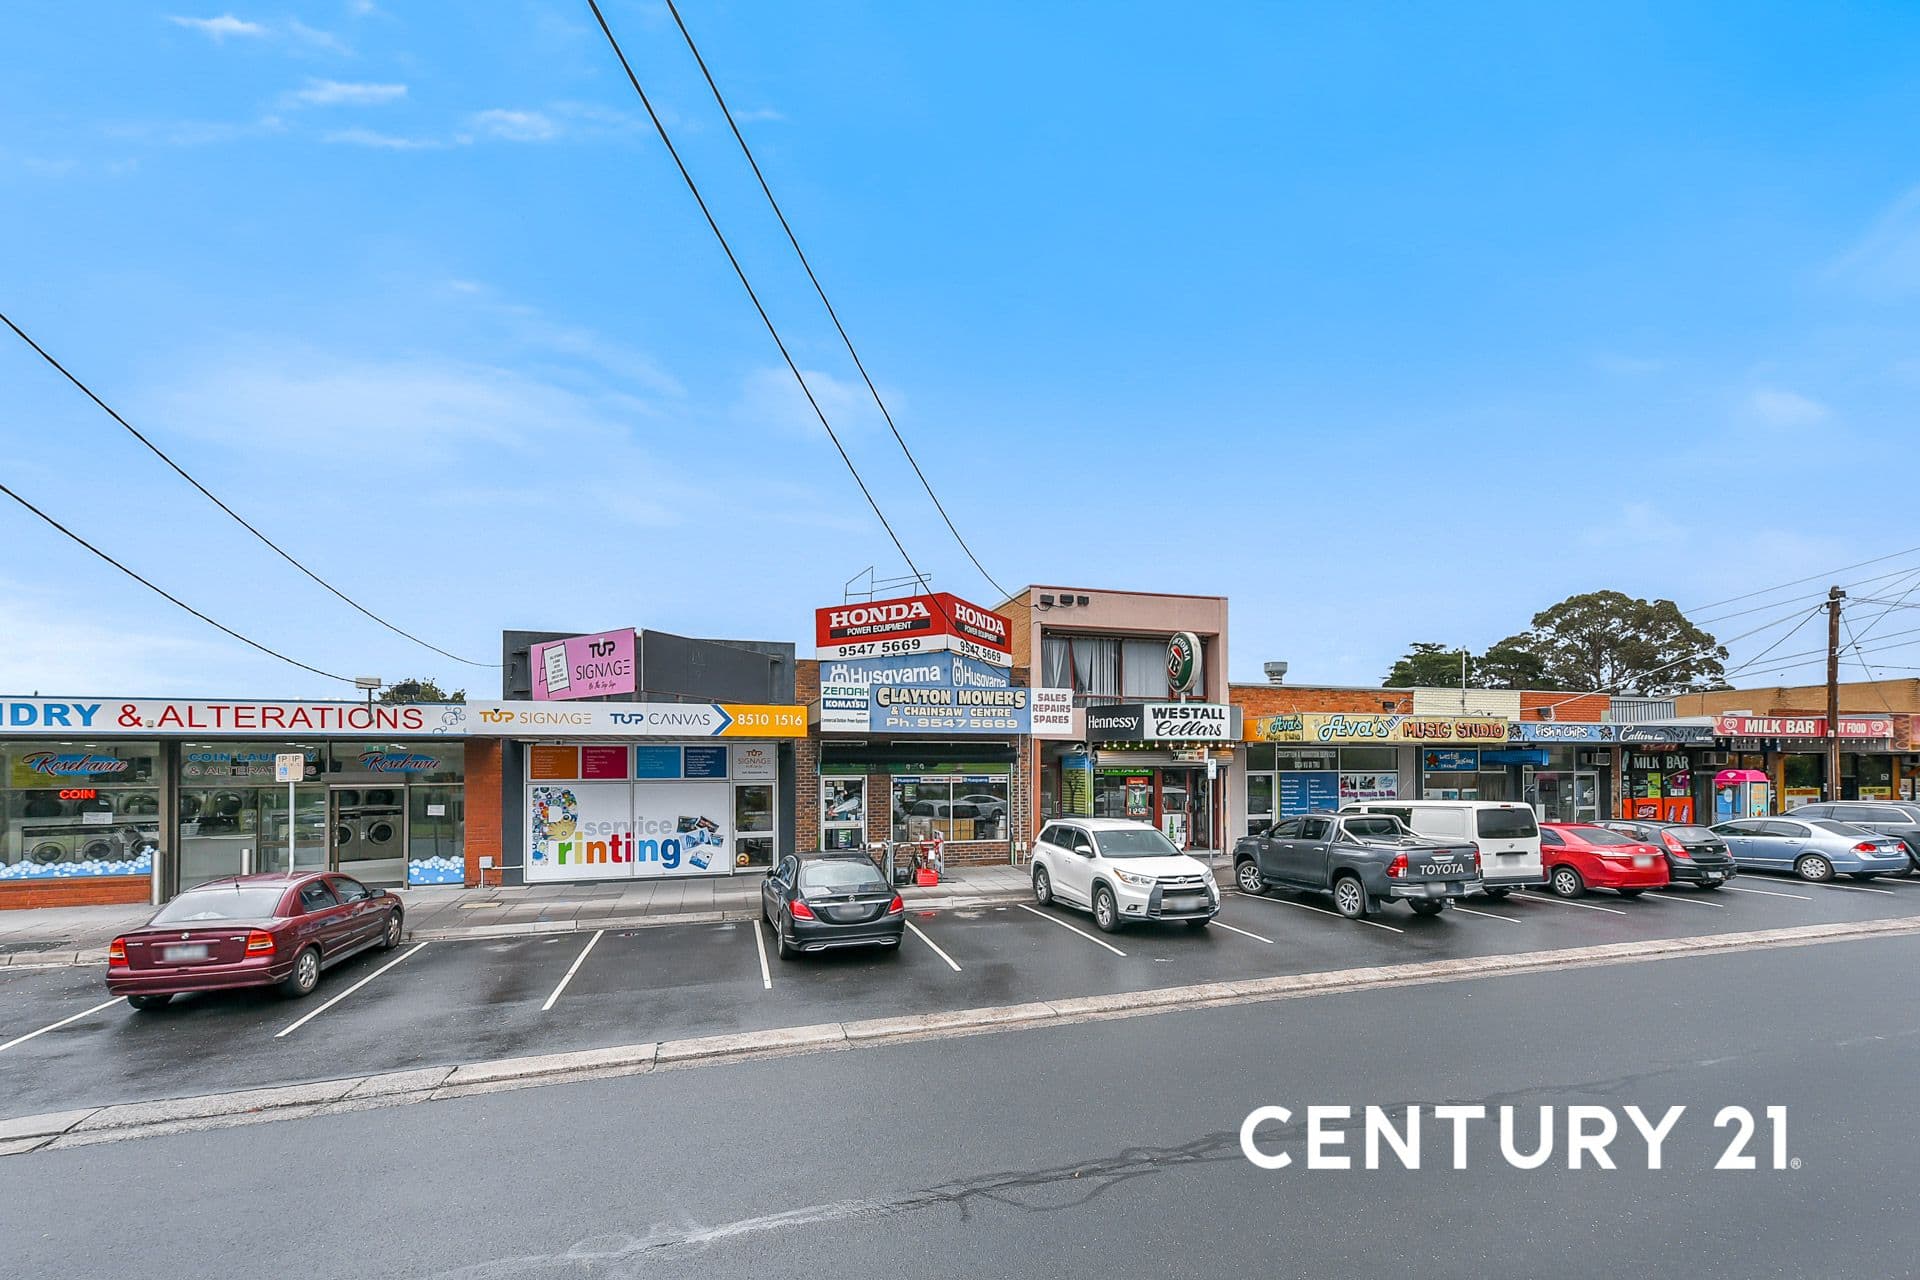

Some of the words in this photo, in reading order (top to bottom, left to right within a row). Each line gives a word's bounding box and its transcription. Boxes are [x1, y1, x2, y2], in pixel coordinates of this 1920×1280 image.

[830, 602, 931, 628] HONDA
[955, 603, 1006, 637] HONDA
[847, 627, 872, 636] POWER
[873, 621, 912, 633] EQUIPMENT
[839, 643, 876, 657] 9547
[882, 639, 921, 652] 5669
[960, 641, 980, 655] 9547
[983, 648, 1001, 662] 5669
[576, 659, 630, 681] SIGNAGE
[823, 686, 869, 696] ZENOAH
[1037, 693, 1067, 702] SALES
[825, 700, 867, 709] KOMATSU
[877, 687, 951, 707] CLAYTON
[957, 690, 1026, 709] MOWERS
[891, 706, 899, 715] &
[904, 706, 963, 717] CHAINSAW
[970, 708, 1012, 717] CENTRE
[1032, 704, 1071, 713] REPAIRS
[1152, 708, 1226, 719] WESTALL
[118, 704, 143, 727] &
[157, 705, 424, 729] ALTERATIONS
[520, 712, 592, 725] SIGNAGE
[648, 713, 711, 726] CANVAS
[737, 714, 769, 726] 8510
[775, 715, 803, 726] 1516
[1033, 715, 1069, 724] SPARES
[1088, 715, 1139, 731] Hennessy
[1156, 720, 1222, 737] Cellars
[1270, 715, 1303, 733] Ava's
[1318, 715, 1390, 741] Ava's
[1403, 722, 1452, 738] MUSIC
[1455, 722, 1505, 738] STUDIO
[1744, 720, 1781, 733] MILK
[1786, 720, 1815, 733] BAR
[1847, 722, 1867, 733] FOOD
[188, 752, 231, 762] COIN
[1633, 756, 1660, 769] MILK
[1666, 756, 1690, 769] BAR
[59, 790, 96, 799] COIN
[1341, 790, 1359, 799] Bring
[1359, 790, 1377, 798] music
[1379, 789, 1386, 798] to
[584, 816, 673, 836] service
[1420, 863, 1464, 875] TOYOTA
